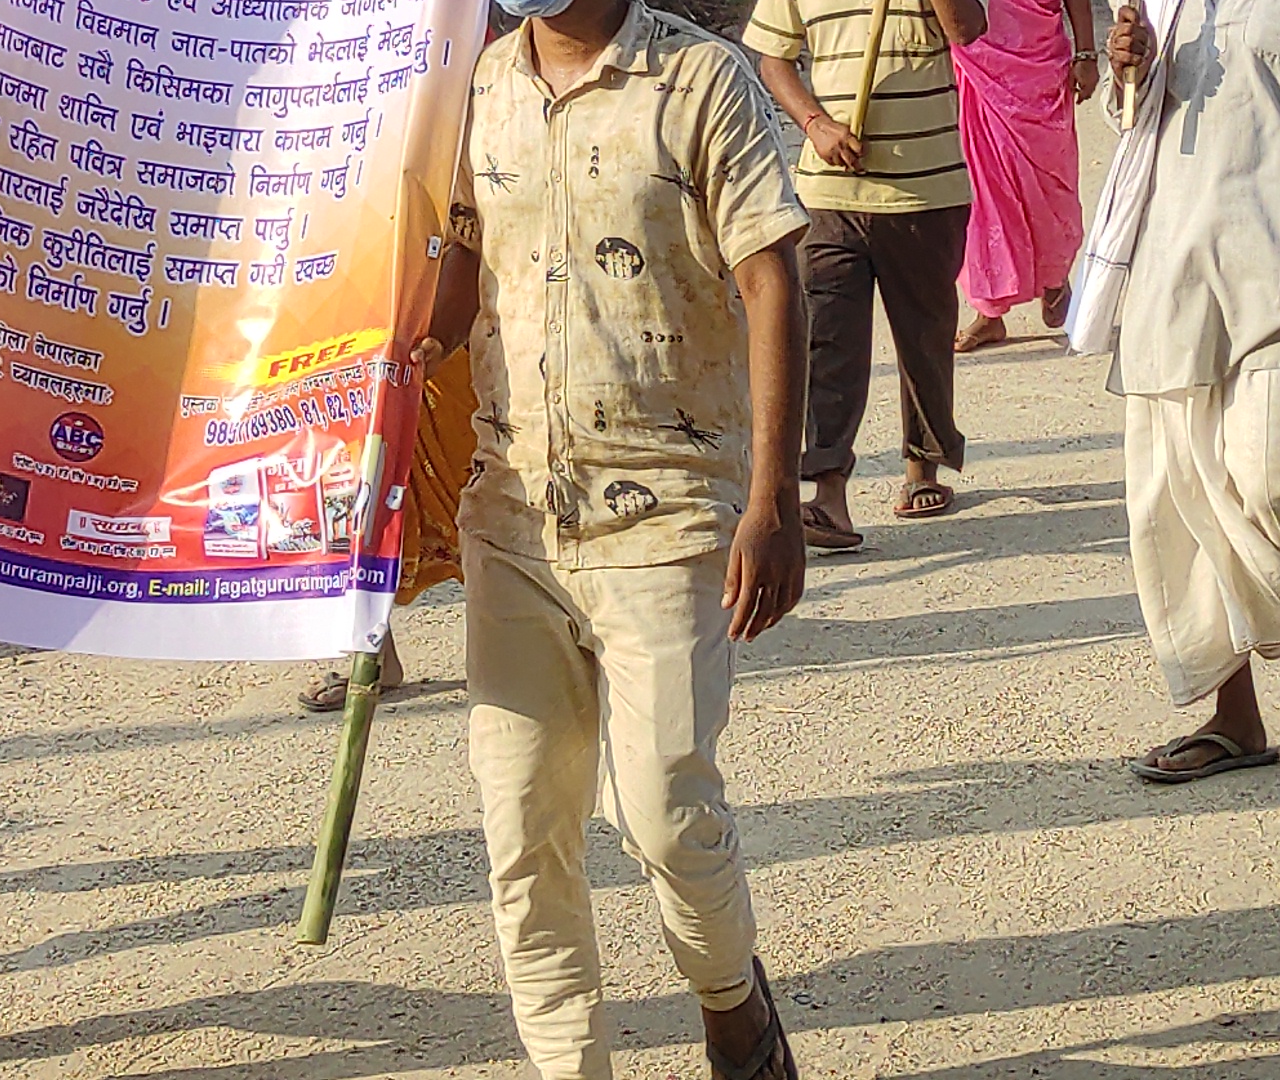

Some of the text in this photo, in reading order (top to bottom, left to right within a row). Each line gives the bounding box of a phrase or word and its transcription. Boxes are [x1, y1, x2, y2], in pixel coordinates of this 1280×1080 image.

[171, 31, 298, 65] जात-पातको
[308, 24, 376, 64] भेदलाई
[78, 49, 115, 85] सबै
[125, 58, 234, 105] किसिमका
[377, 63, 413, 95] समा
[57, 92, 120, 132] शान्ति
[130, 108, 165, 141] एवं
[274, 125, 335, 152] कायम
[341, 107, 375, 151] गर्नु
[9, 119, 60, 162] रहित
[70, 138, 127, 180] पवित्र
[137, 160, 237, 198] समाजको
[248, 162, 313, 200] निर्माण
[321, 154, 353, 199] गर्नु
[77, 187, 158, 233] जरैदेखि
[170, 211, 244, 241] समाप्त
[255, 207, 295, 251] पार्नु
[42, 228, 157, 282] कुरीतिलाई
[164, 255, 240, 286] समाप्त
[250, 252, 287, 287] गरी
[26, 265, 99, 315] निर्माण
[108, 287, 152, 335] गर्नु
[32, 333, 103, 373] नेपालका
[268, 337, 358, 379] FREE
[51, 422, 103, 448] ABC
[148, 578, 211, 599] E-mail:
